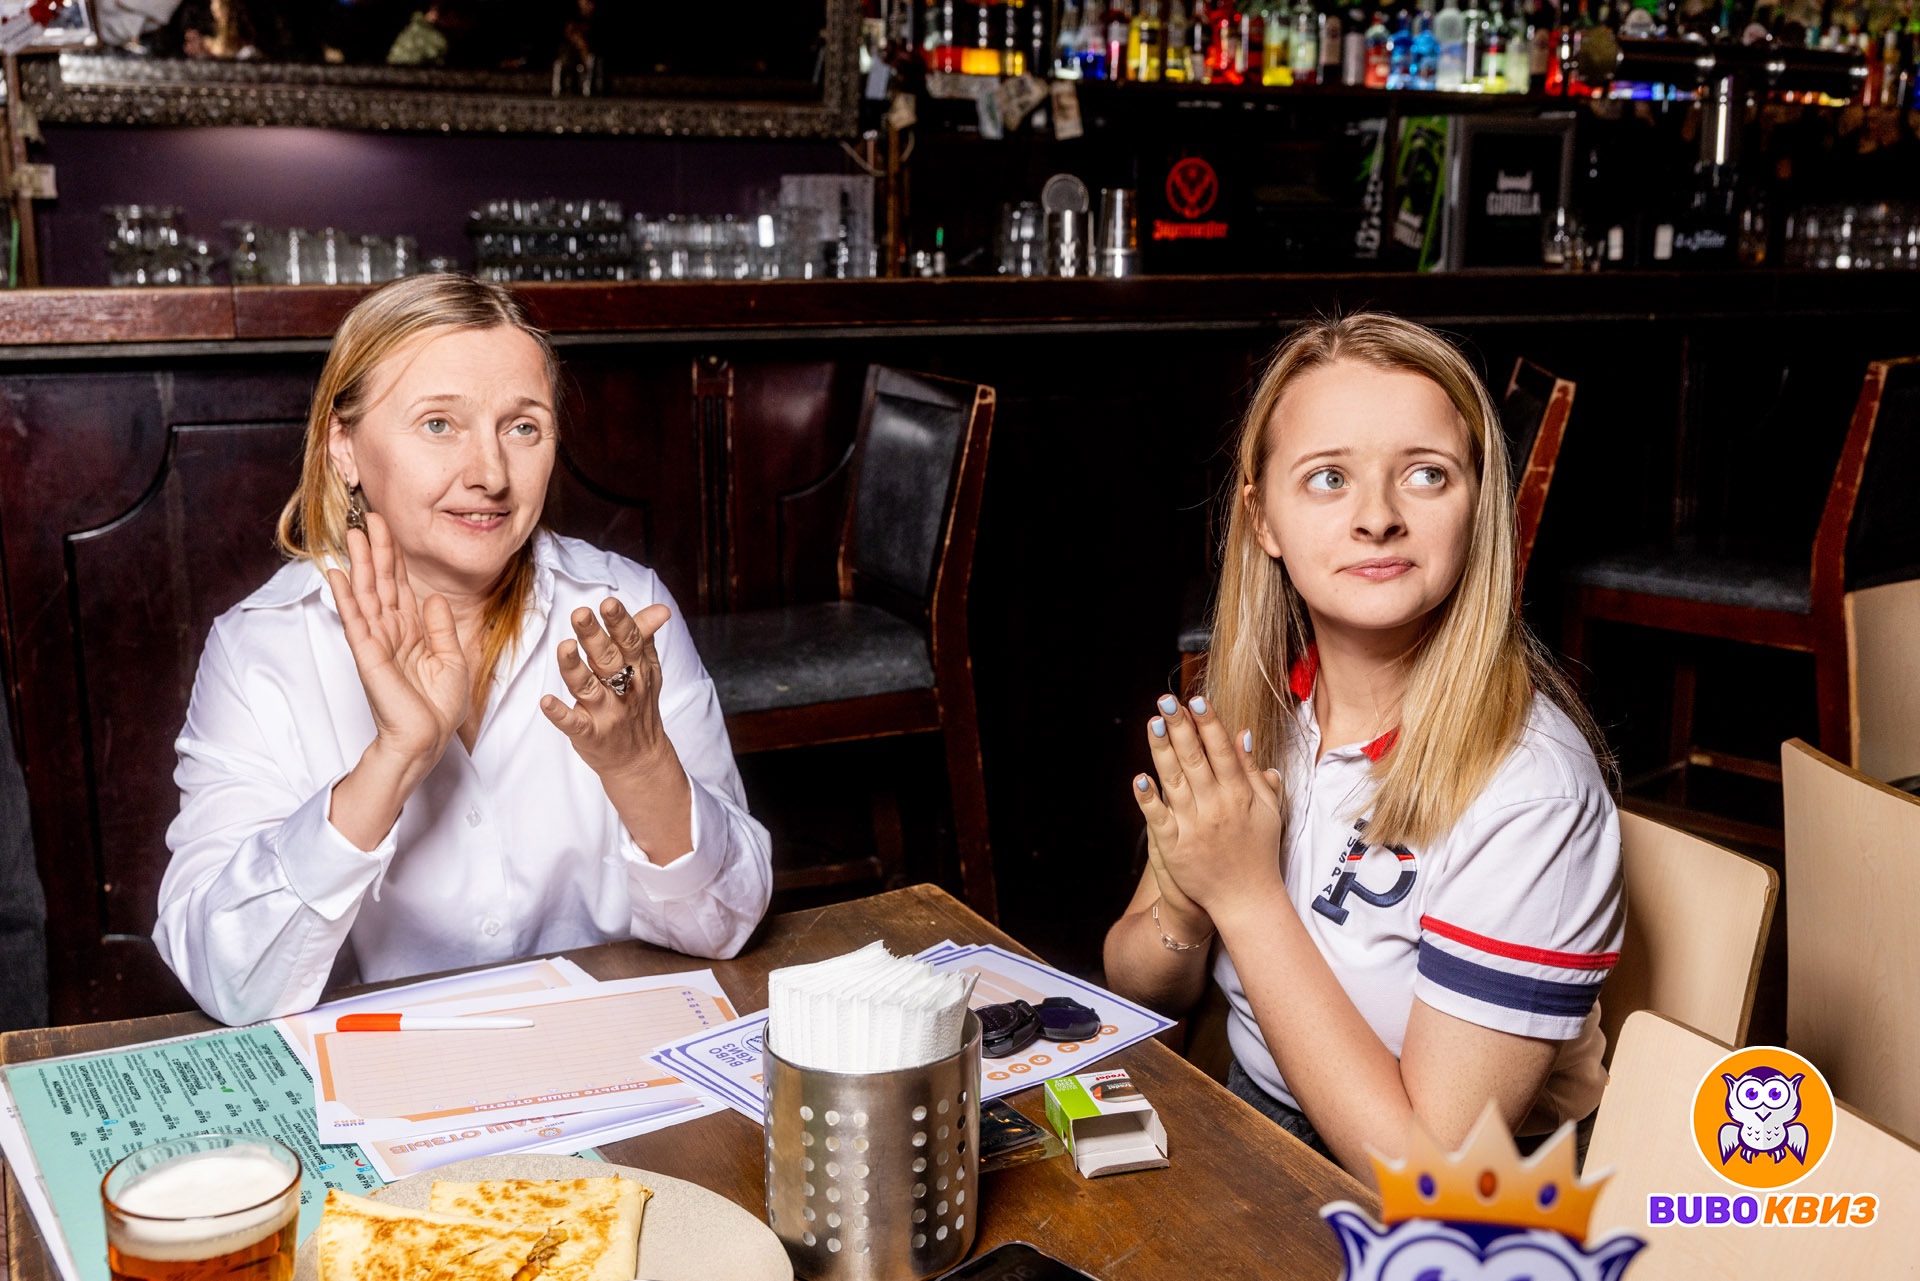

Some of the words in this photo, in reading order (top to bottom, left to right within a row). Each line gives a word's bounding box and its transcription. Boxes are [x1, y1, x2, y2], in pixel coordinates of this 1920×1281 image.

[1486, 192, 1541, 216] GORILLA
[708, 1047, 744, 1068] BUBO
[722, 1043, 757, 1063] КВИЗ
[1095, 1073, 1126, 1081] trodat
[584, 1081, 649, 1096] Сверьте
[474, 1098, 532, 1112] ответы
[536, 1092, 580, 1103] ваши
[292, 1123, 306, 1134] САЛАТ
[312, 1152, 327, 1166] КАРНЕ
[389, 1129, 482, 1155] ОТЗЫВ
[360, 1180, 372, 1189] РУБ
